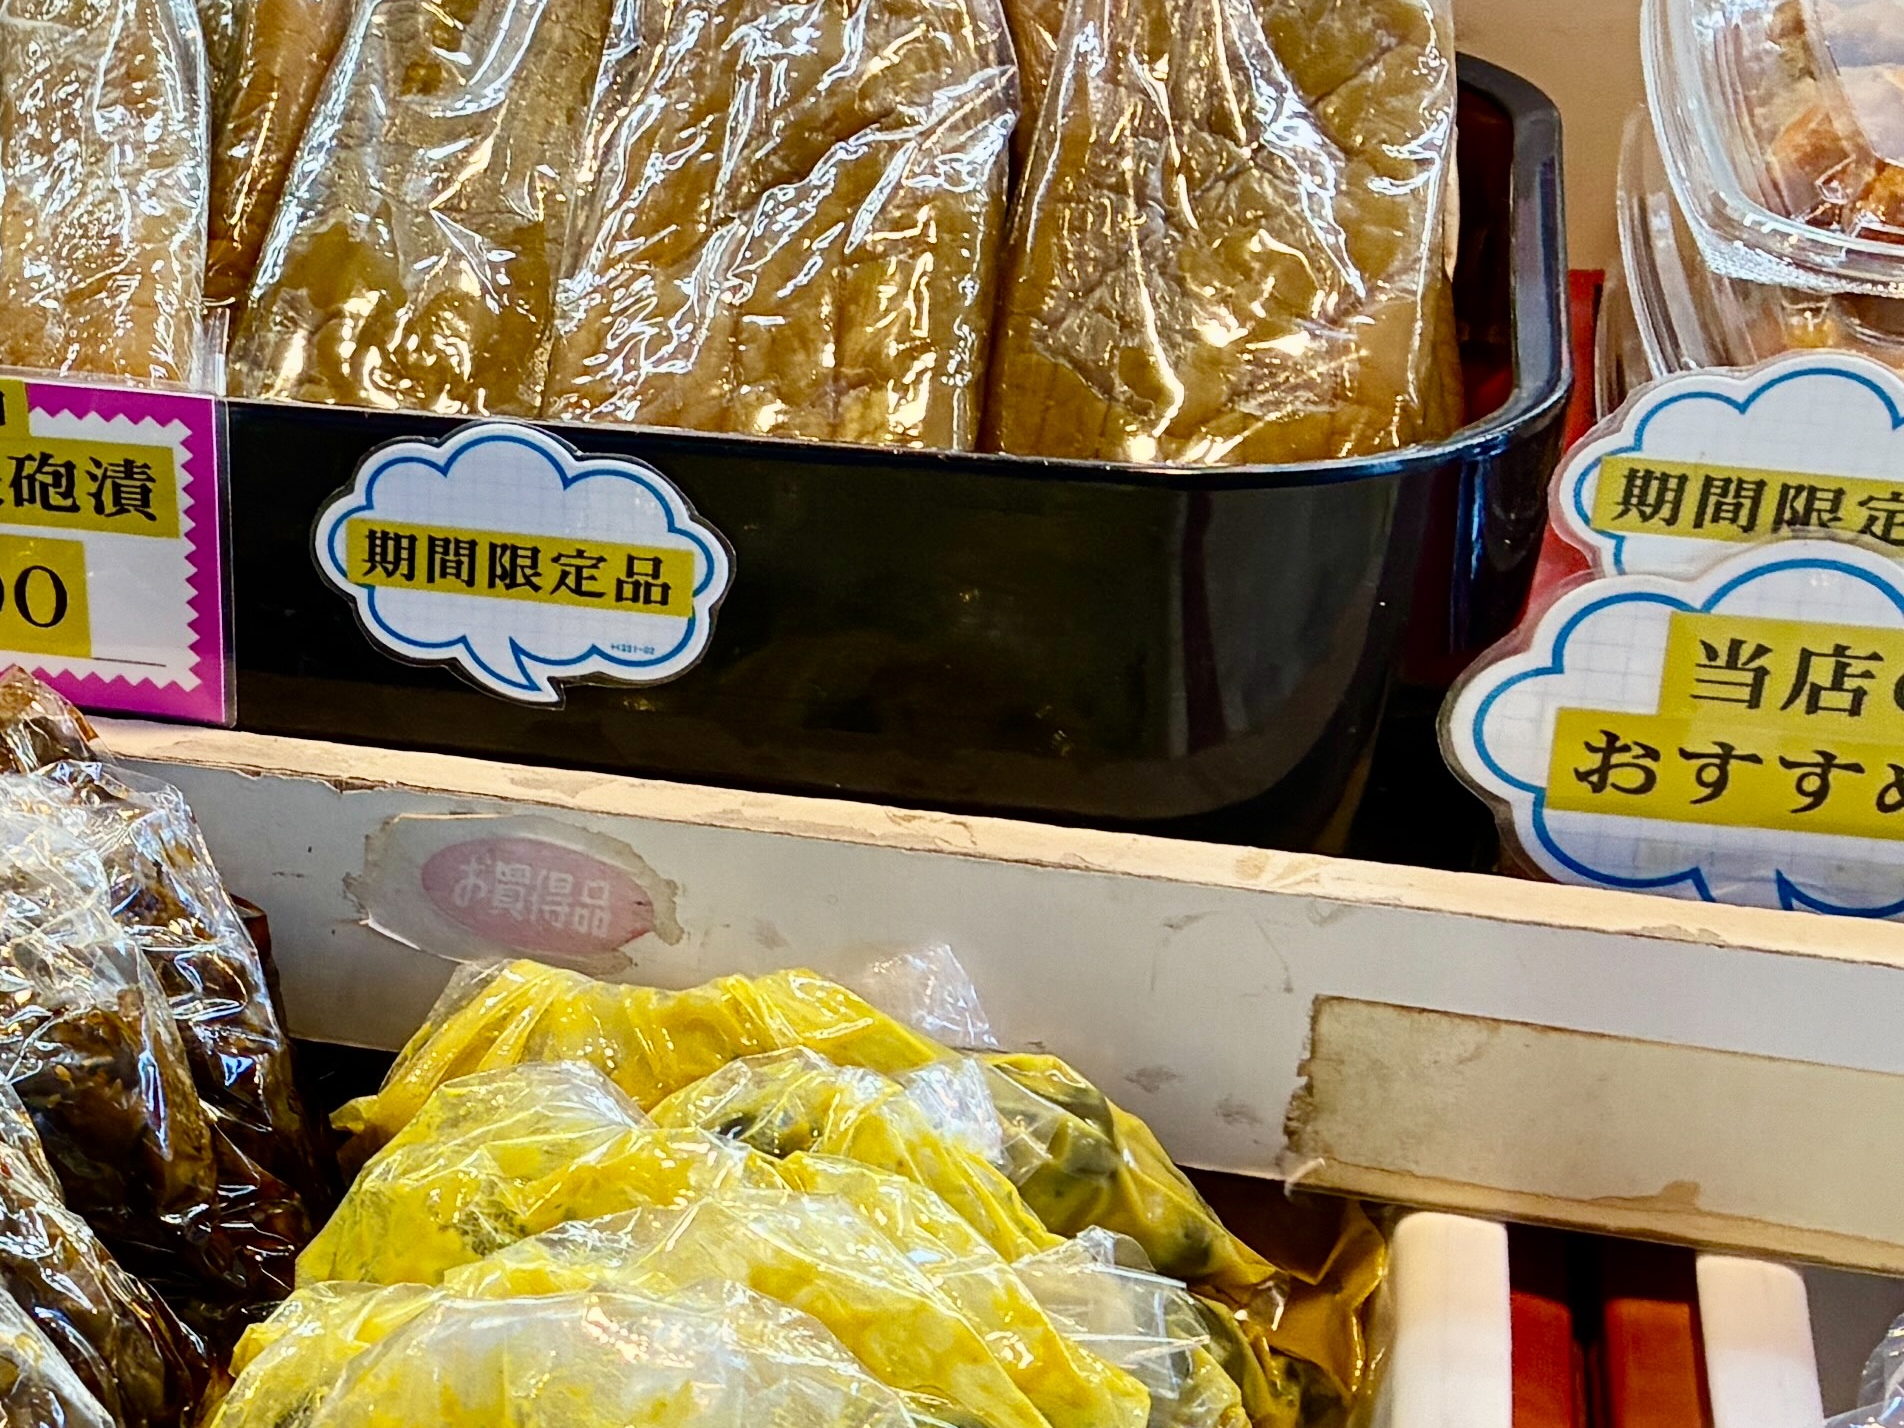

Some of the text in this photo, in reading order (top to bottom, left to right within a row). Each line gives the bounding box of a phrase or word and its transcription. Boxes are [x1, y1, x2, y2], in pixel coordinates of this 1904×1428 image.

[361, 529, 673, 607] 期間限定品
[1689, 638, 1904, 719] 当店
